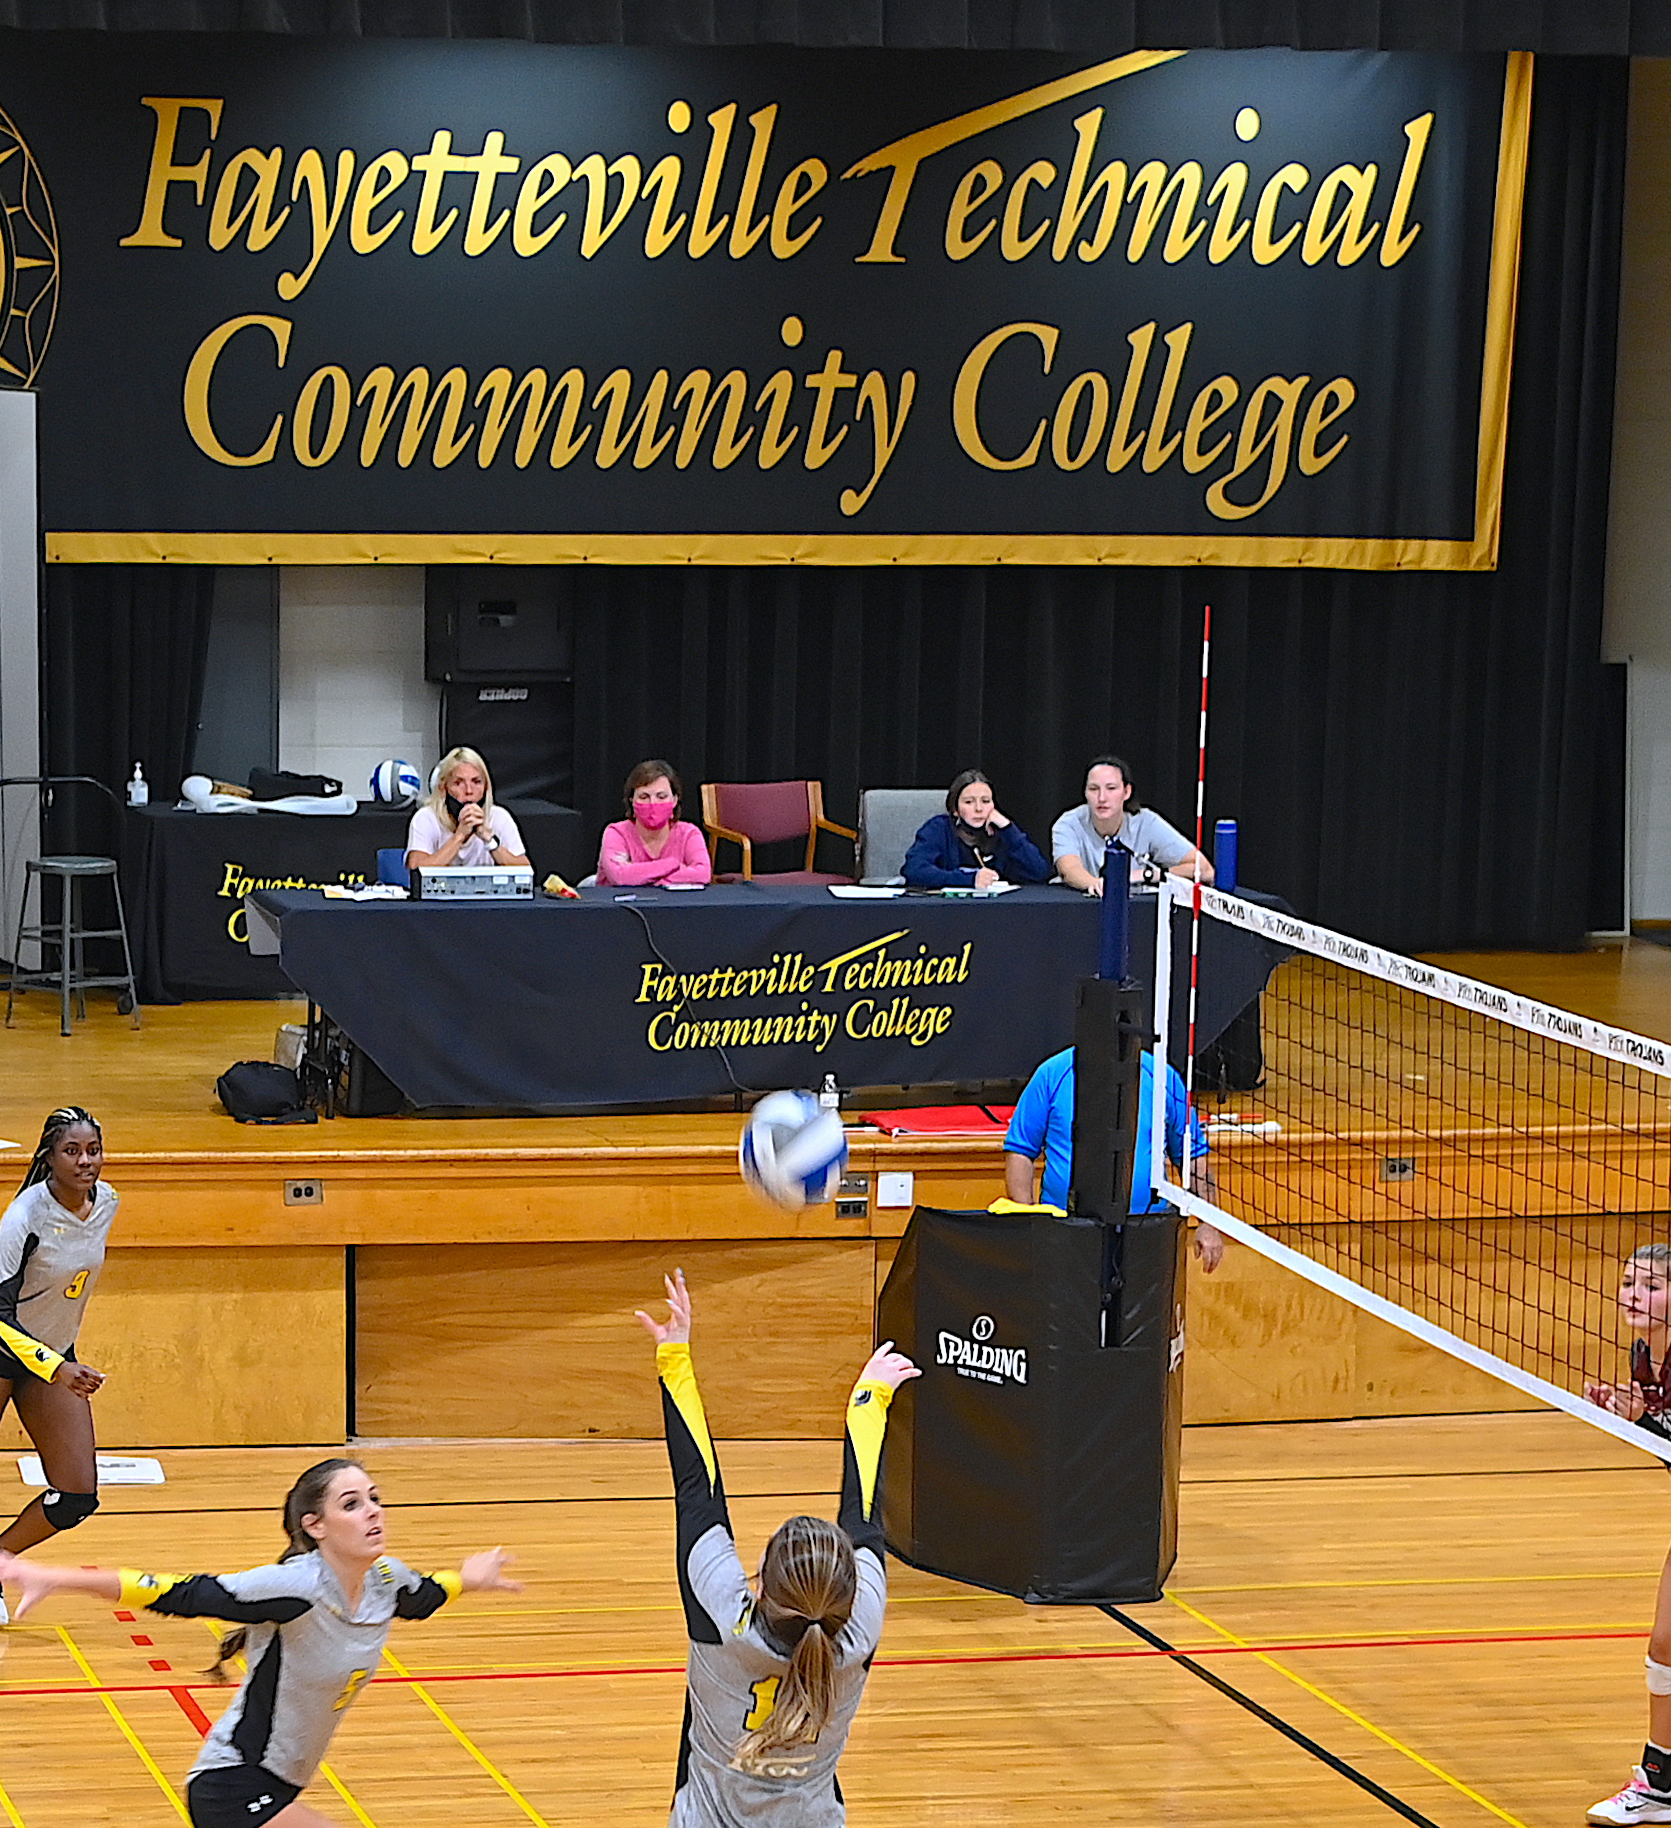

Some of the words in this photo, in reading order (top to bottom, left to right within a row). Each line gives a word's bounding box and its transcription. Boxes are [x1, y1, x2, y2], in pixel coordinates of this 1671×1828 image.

[120, 97, 828, 301] Fayetteville
[841, 49, 1434, 267] Technical
[184, 314, 917, 516] Community
[953, 321, 1356, 520] College
[635, 953, 815, 1012] Fayetteville
[818, 928, 973, 993] Technical
[648, 1001, 838, 1053] Community
[846, 996, 953, 1047] College
[936, 1330, 1027, 1384] SPALDING
